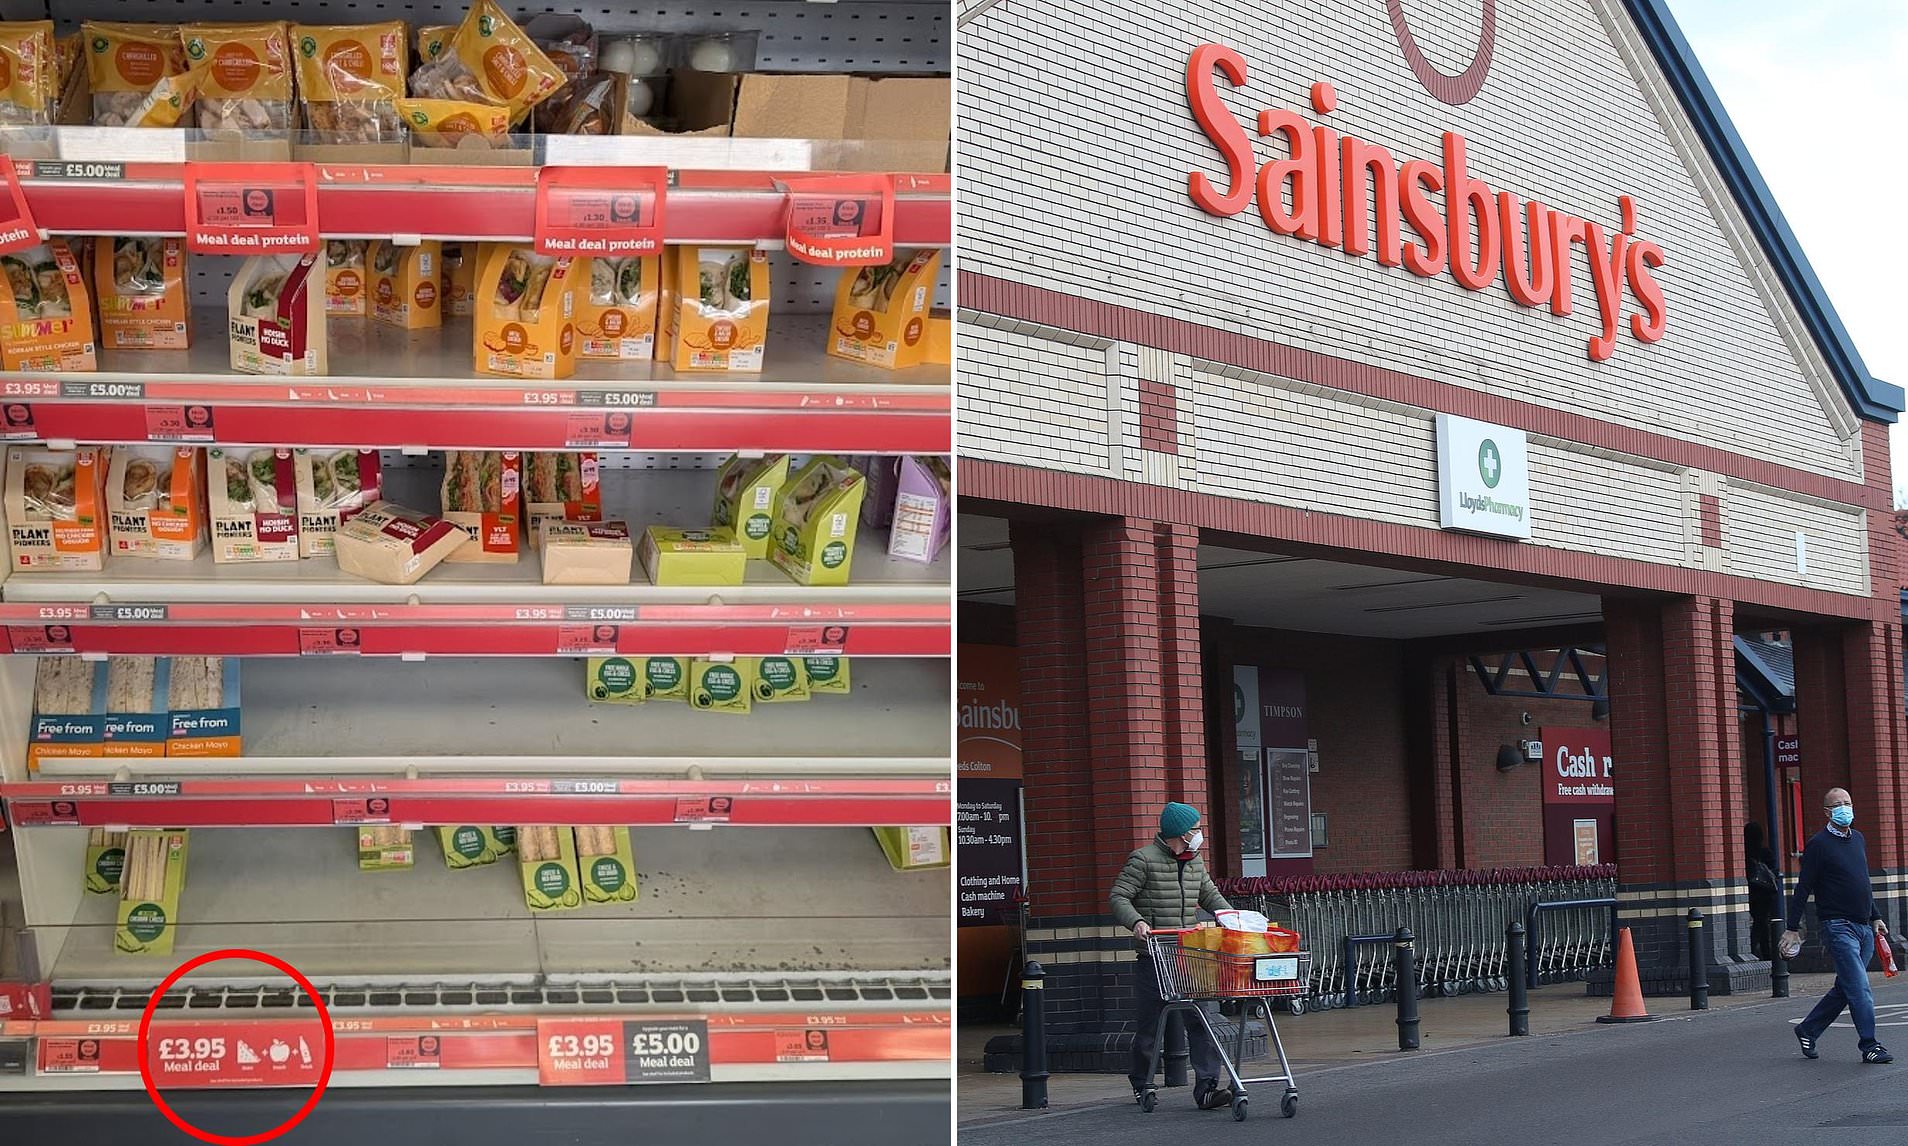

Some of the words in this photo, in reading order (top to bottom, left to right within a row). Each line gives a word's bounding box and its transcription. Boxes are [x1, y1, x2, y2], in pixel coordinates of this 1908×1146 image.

[66, 164, 104, 177] £5.00
[1185, 43, 1667, 362] Sainsbury's
[196, 234, 228, 245] Meal
[232, 234, 260, 246] deal
[262, 234, 310, 248] protein
[544, 238, 576, 249] Meal
[578, 238, 606, 250] deal
[609, 238, 654, 251] protein
[808, 246, 832, 258] deal
[836, 246, 884, 260] protein
[232, 322, 256, 337] PLANT
[272, 337, 289, 348] DUCK
[6, 383, 40, 395] £3.95
[90, 384, 126, 396] £5.00
[524, 393, 557, 404] £3.95
[605, 393, 638, 405] £5.00
[1459, 492, 1523, 522] LloydsPharmacy
[112, 515, 146, 526] PLANT
[302, 516, 336, 527] PLANT
[216, 521, 252, 532] PLANT
[12, 529, 50, 539] PLANT
[40, 608, 71, 618] £3.95
[118, 608, 149, 619] £5.00
[516, 609, 546, 619] £3.95
[590, 609, 622, 619] £5.00
[1264, 705, 1303, 719] TIMPSON
[38, 722, 63, 734] Free
[65, 723, 92, 734] from
[106, 721, 124, 732] ree
[126, 721, 154, 732] from
[173, 717, 197, 729] Free
[199, 717, 227, 728] from
[130, 746, 152, 755] Mayo
[172, 742, 204, 750] Chicken
[206, 741, 228, 750] Mayo
[970, 761, 991, 771] Colton
[1557, 746, 1597, 777] Cash
[61, 785, 91, 795] £3.95
[134, 785, 164, 794] £5.00
[1558, 783, 1573, 795] Free
[1573, 784, 1587, 795] cash
[982, 802, 1002, 812] Saturday
[999, 813, 1009, 823] pm
[958, 826, 975, 834] Sunday
[958, 836, 984, 845] 10.30am
[988, 835, 1012, 846] 4.30pm
[960, 876, 987, 888] Clothing
[988, 876, 1000, 885] and
[1002, 875, 1020, 884] Home
[961, 891, 976, 901] Cash
[978, 891, 1005, 900] machine
[962, 907, 984, 918] Bakery
[807, 1016, 834, 1024] £3.95
[88, 1024, 116, 1033] £3.95
[158, 1037, 226, 1060] £3.95
[548, 1035, 614, 1057] £3.95
[632, 1033, 700, 1055] £5.00
[164, 1061, 192, 1072] Meal
[194, 1060, 219, 1071] deal
[554, 1059, 581, 1070] Meal
[584, 1058, 608, 1069] deal
[640, 1057, 667, 1068] Meal
[669, 1056, 694, 1067] deal
